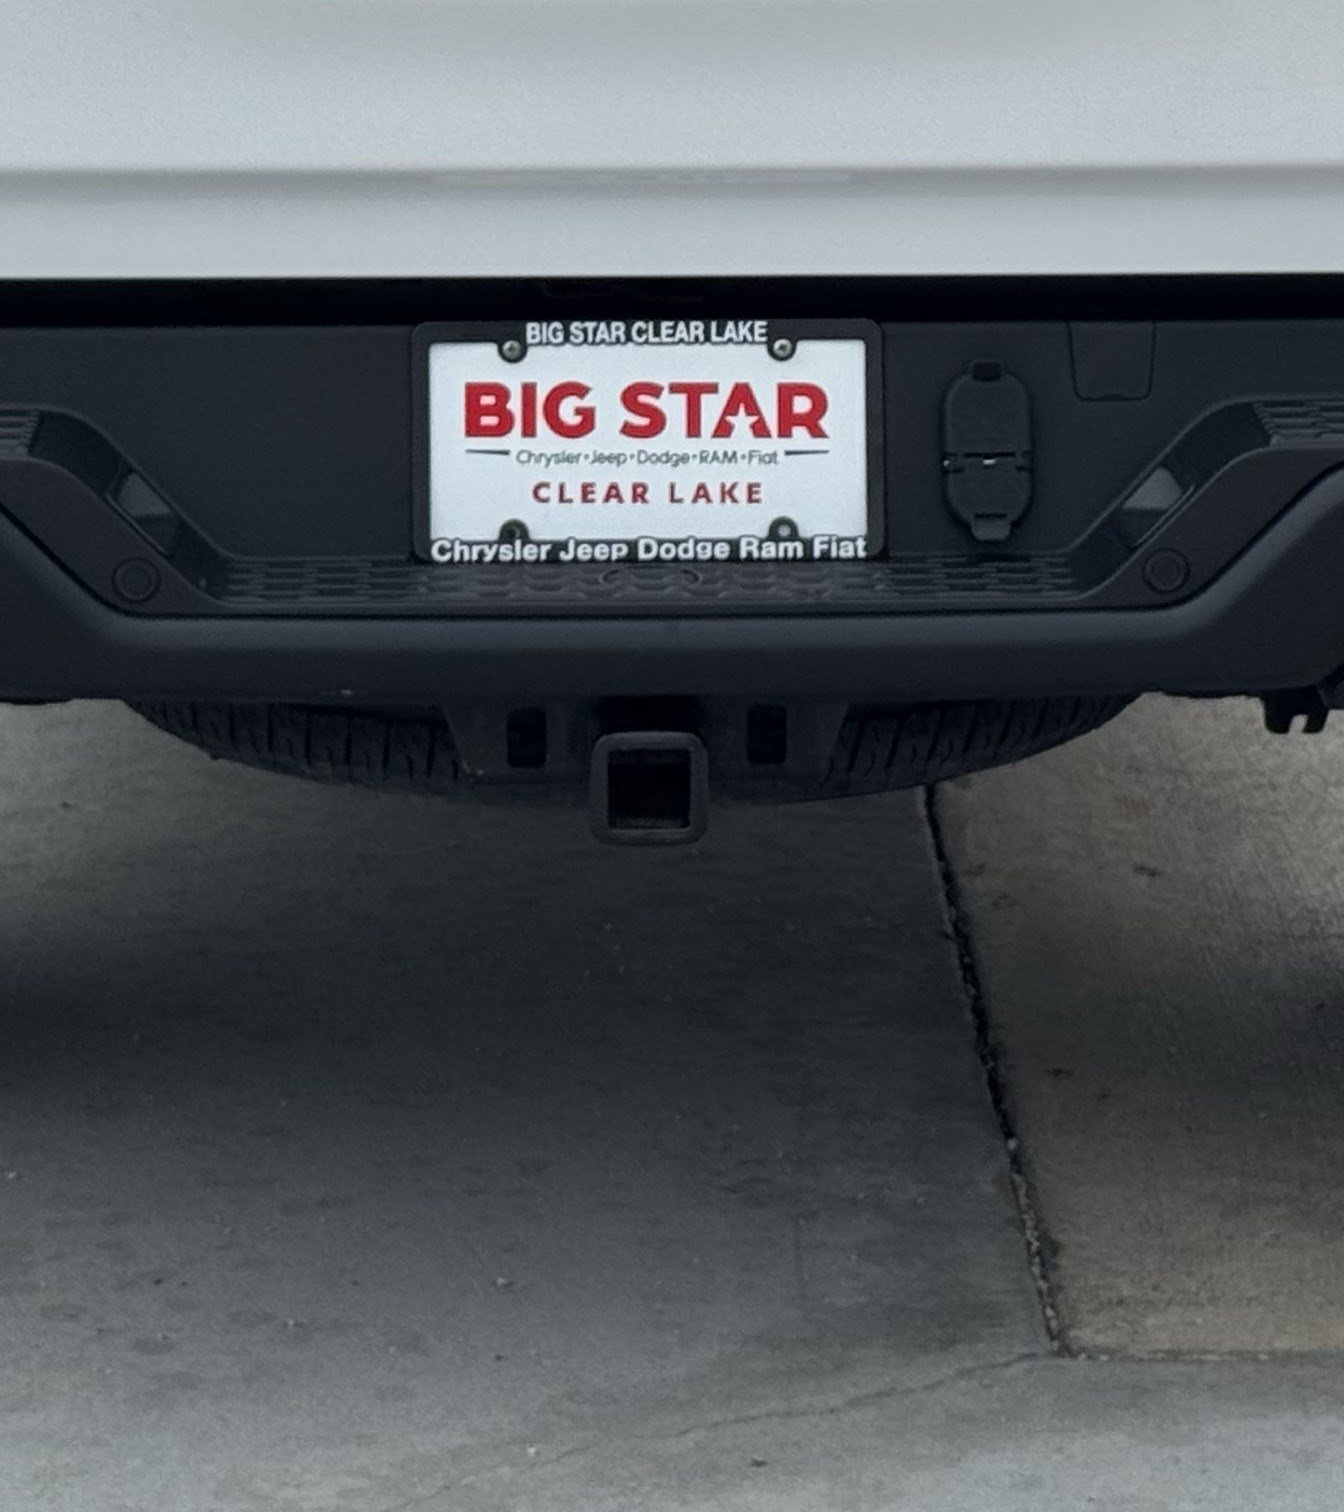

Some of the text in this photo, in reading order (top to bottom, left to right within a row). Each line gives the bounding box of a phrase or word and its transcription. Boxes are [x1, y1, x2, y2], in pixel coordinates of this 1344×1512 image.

[526, 320, 769, 345] BIG STAR CLEAR LAKE
[464, 381, 830, 439] BIG STAR
[531, 481, 763, 504] CLEAR LAKE
[431, 535, 867, 562] Chrysler Jeep Dodge Ram Fiat
